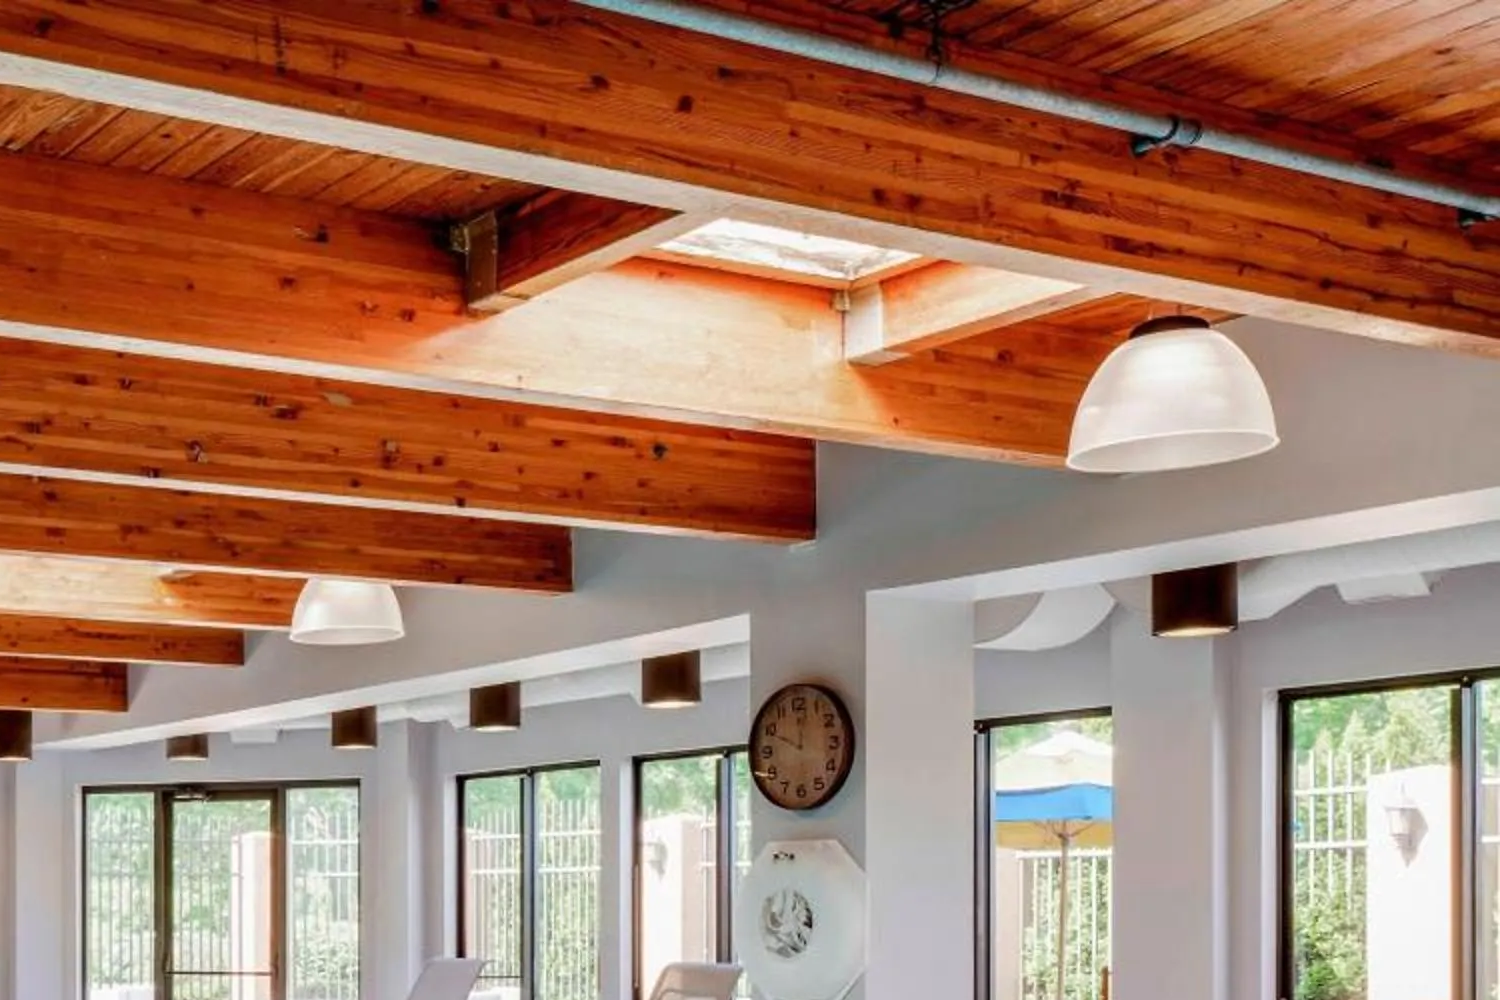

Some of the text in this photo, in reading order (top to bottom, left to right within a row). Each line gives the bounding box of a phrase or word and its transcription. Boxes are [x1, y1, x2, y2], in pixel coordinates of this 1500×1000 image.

[791, 697, 805, 712] 12
[823, 713, 834, 728] 2
[765, 723, 777, 736] 10
[829, 735, 839, 750] 3
[762, 745, 773, 759] 9
[826, 759, 836, 772] 4
[768, 766, 777, 780] 8
[780, 781, 789, 793] 7
[796, 783, 806, 798] 6
[814, 777, 825, 791] 5
